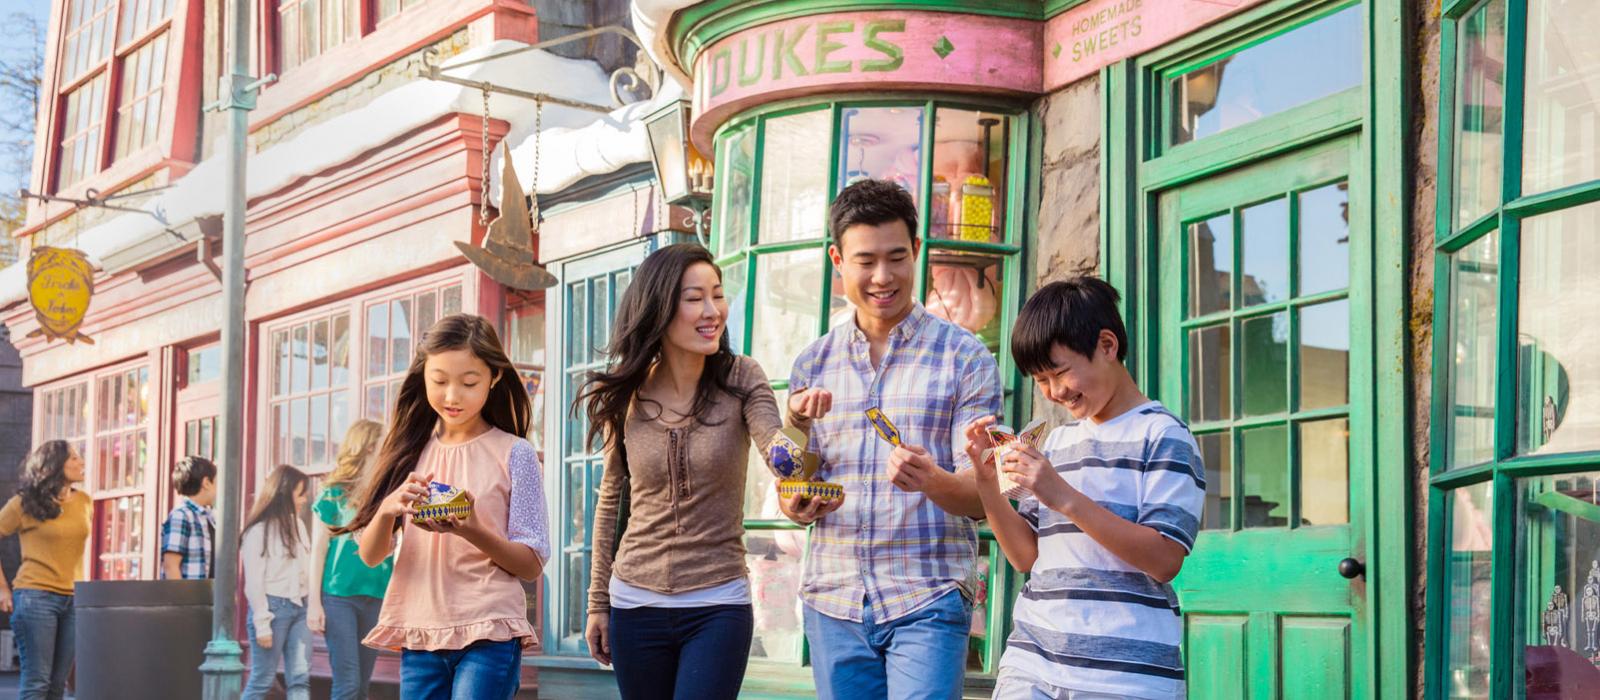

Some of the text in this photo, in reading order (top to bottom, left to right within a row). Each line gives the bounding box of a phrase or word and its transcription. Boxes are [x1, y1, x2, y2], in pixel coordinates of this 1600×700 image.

[1071, 0, 1143, 37] HOMEMADE
[1072, 15, 1142, 63] SWEETS
[711, 18, 906, 98] DUKES
